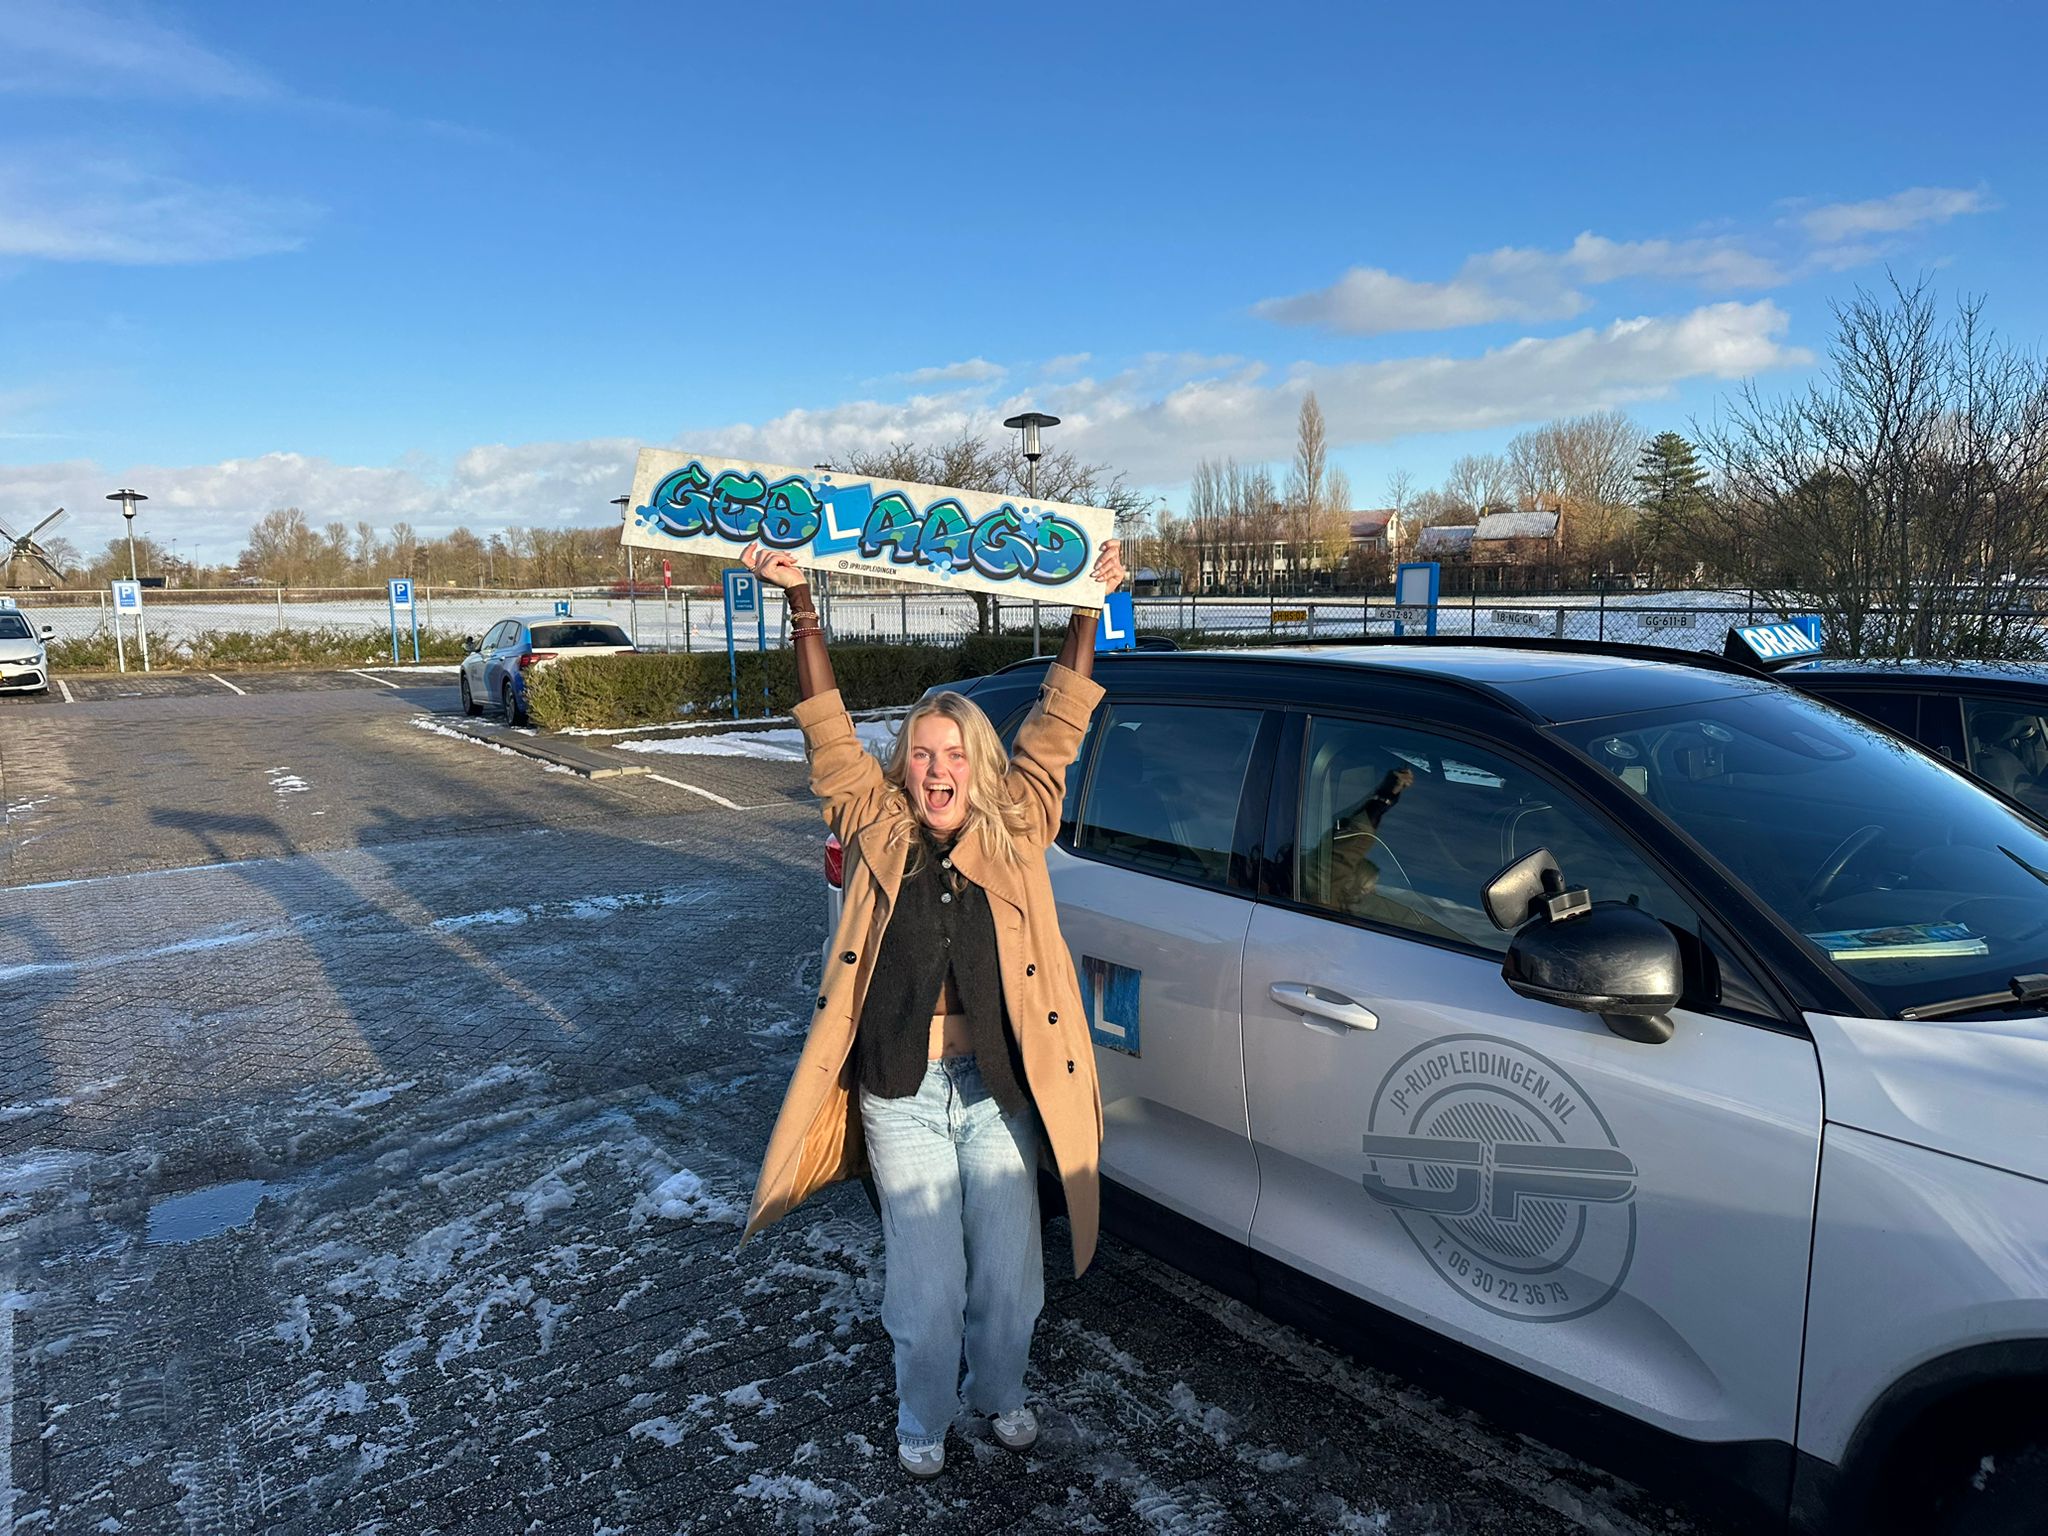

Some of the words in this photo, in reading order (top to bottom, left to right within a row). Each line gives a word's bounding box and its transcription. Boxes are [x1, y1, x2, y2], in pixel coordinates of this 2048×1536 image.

[651, 462, 1091, 586] GESLAAGD
[121, 586, 132, 598] P
[396, 584, 405, 595] P
[737, 578, 749, 596] P
[1103, 603, 1125, 640] L
[1645, 615, 1687, 626] GG-611-B
[1094, 972, 1126, 1038] L
[1390, 1050, 1577, 1126] JP-RIJOPLEIDINGEN.NL
[1447, 1250, 1471, 1277] 06
[1471, 1267, 1494, 1294] 30
[1497, 1278, 1519, 1304] 22
[1522, 1283, 1546, 1306] 36
[1543, 1281, 1569, 1304] 79
